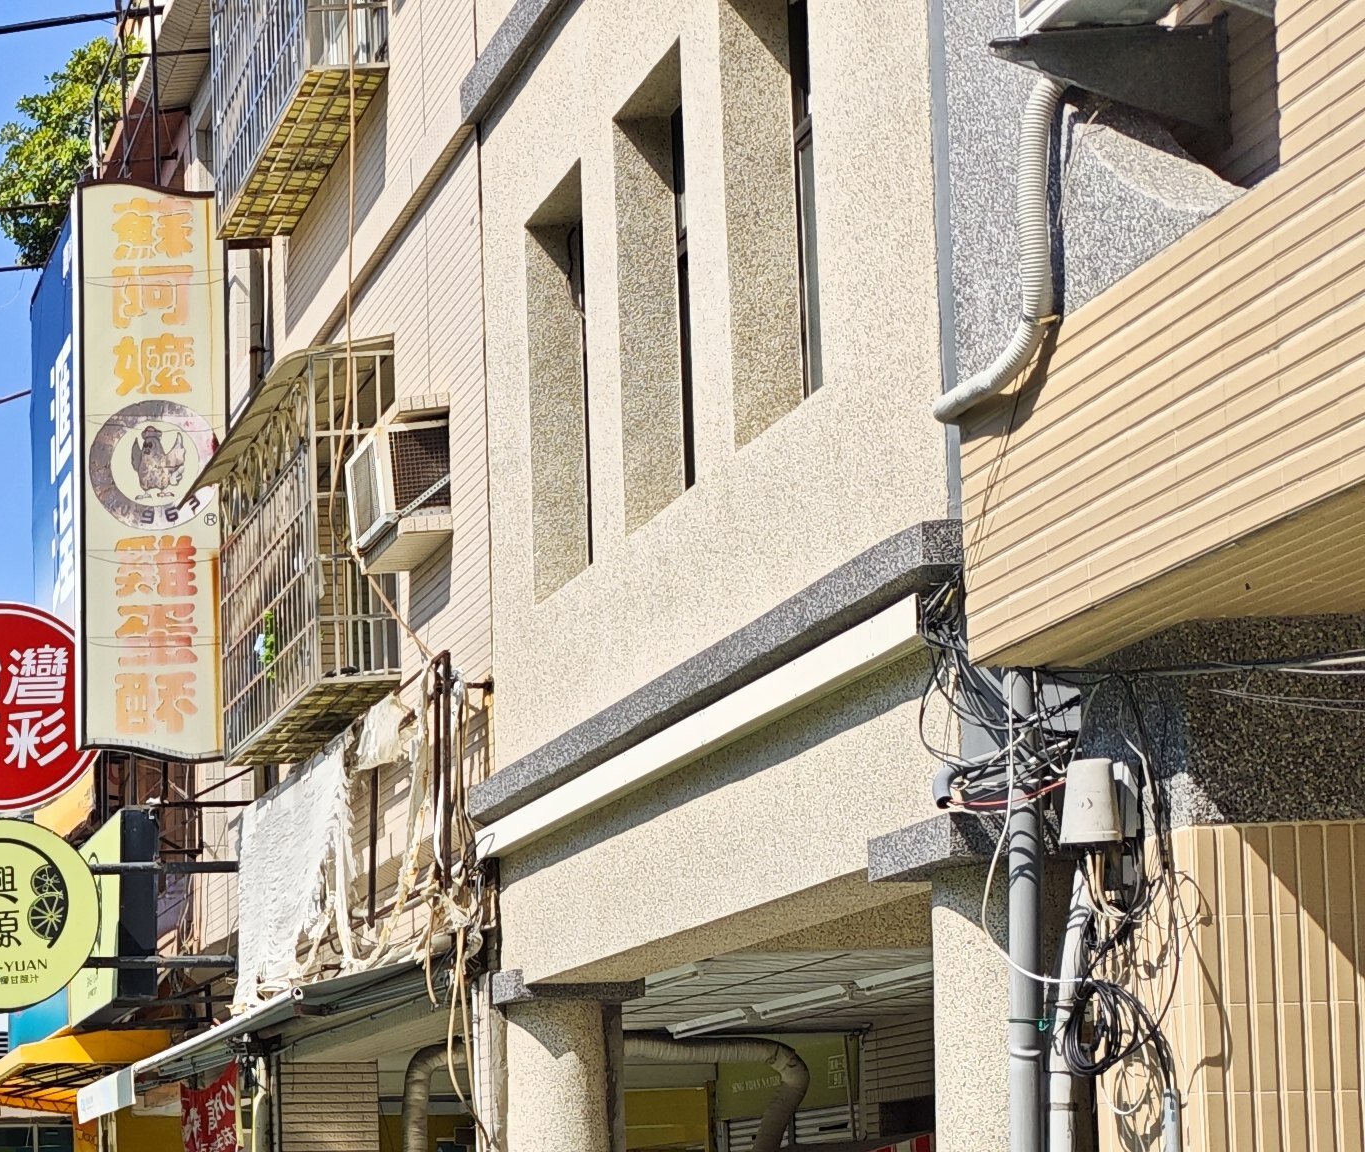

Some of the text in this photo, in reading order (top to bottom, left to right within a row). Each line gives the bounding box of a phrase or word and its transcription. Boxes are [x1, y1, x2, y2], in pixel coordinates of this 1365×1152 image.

[111, 197, 198, 734] 蘇阿嬤 雞蛋酥
